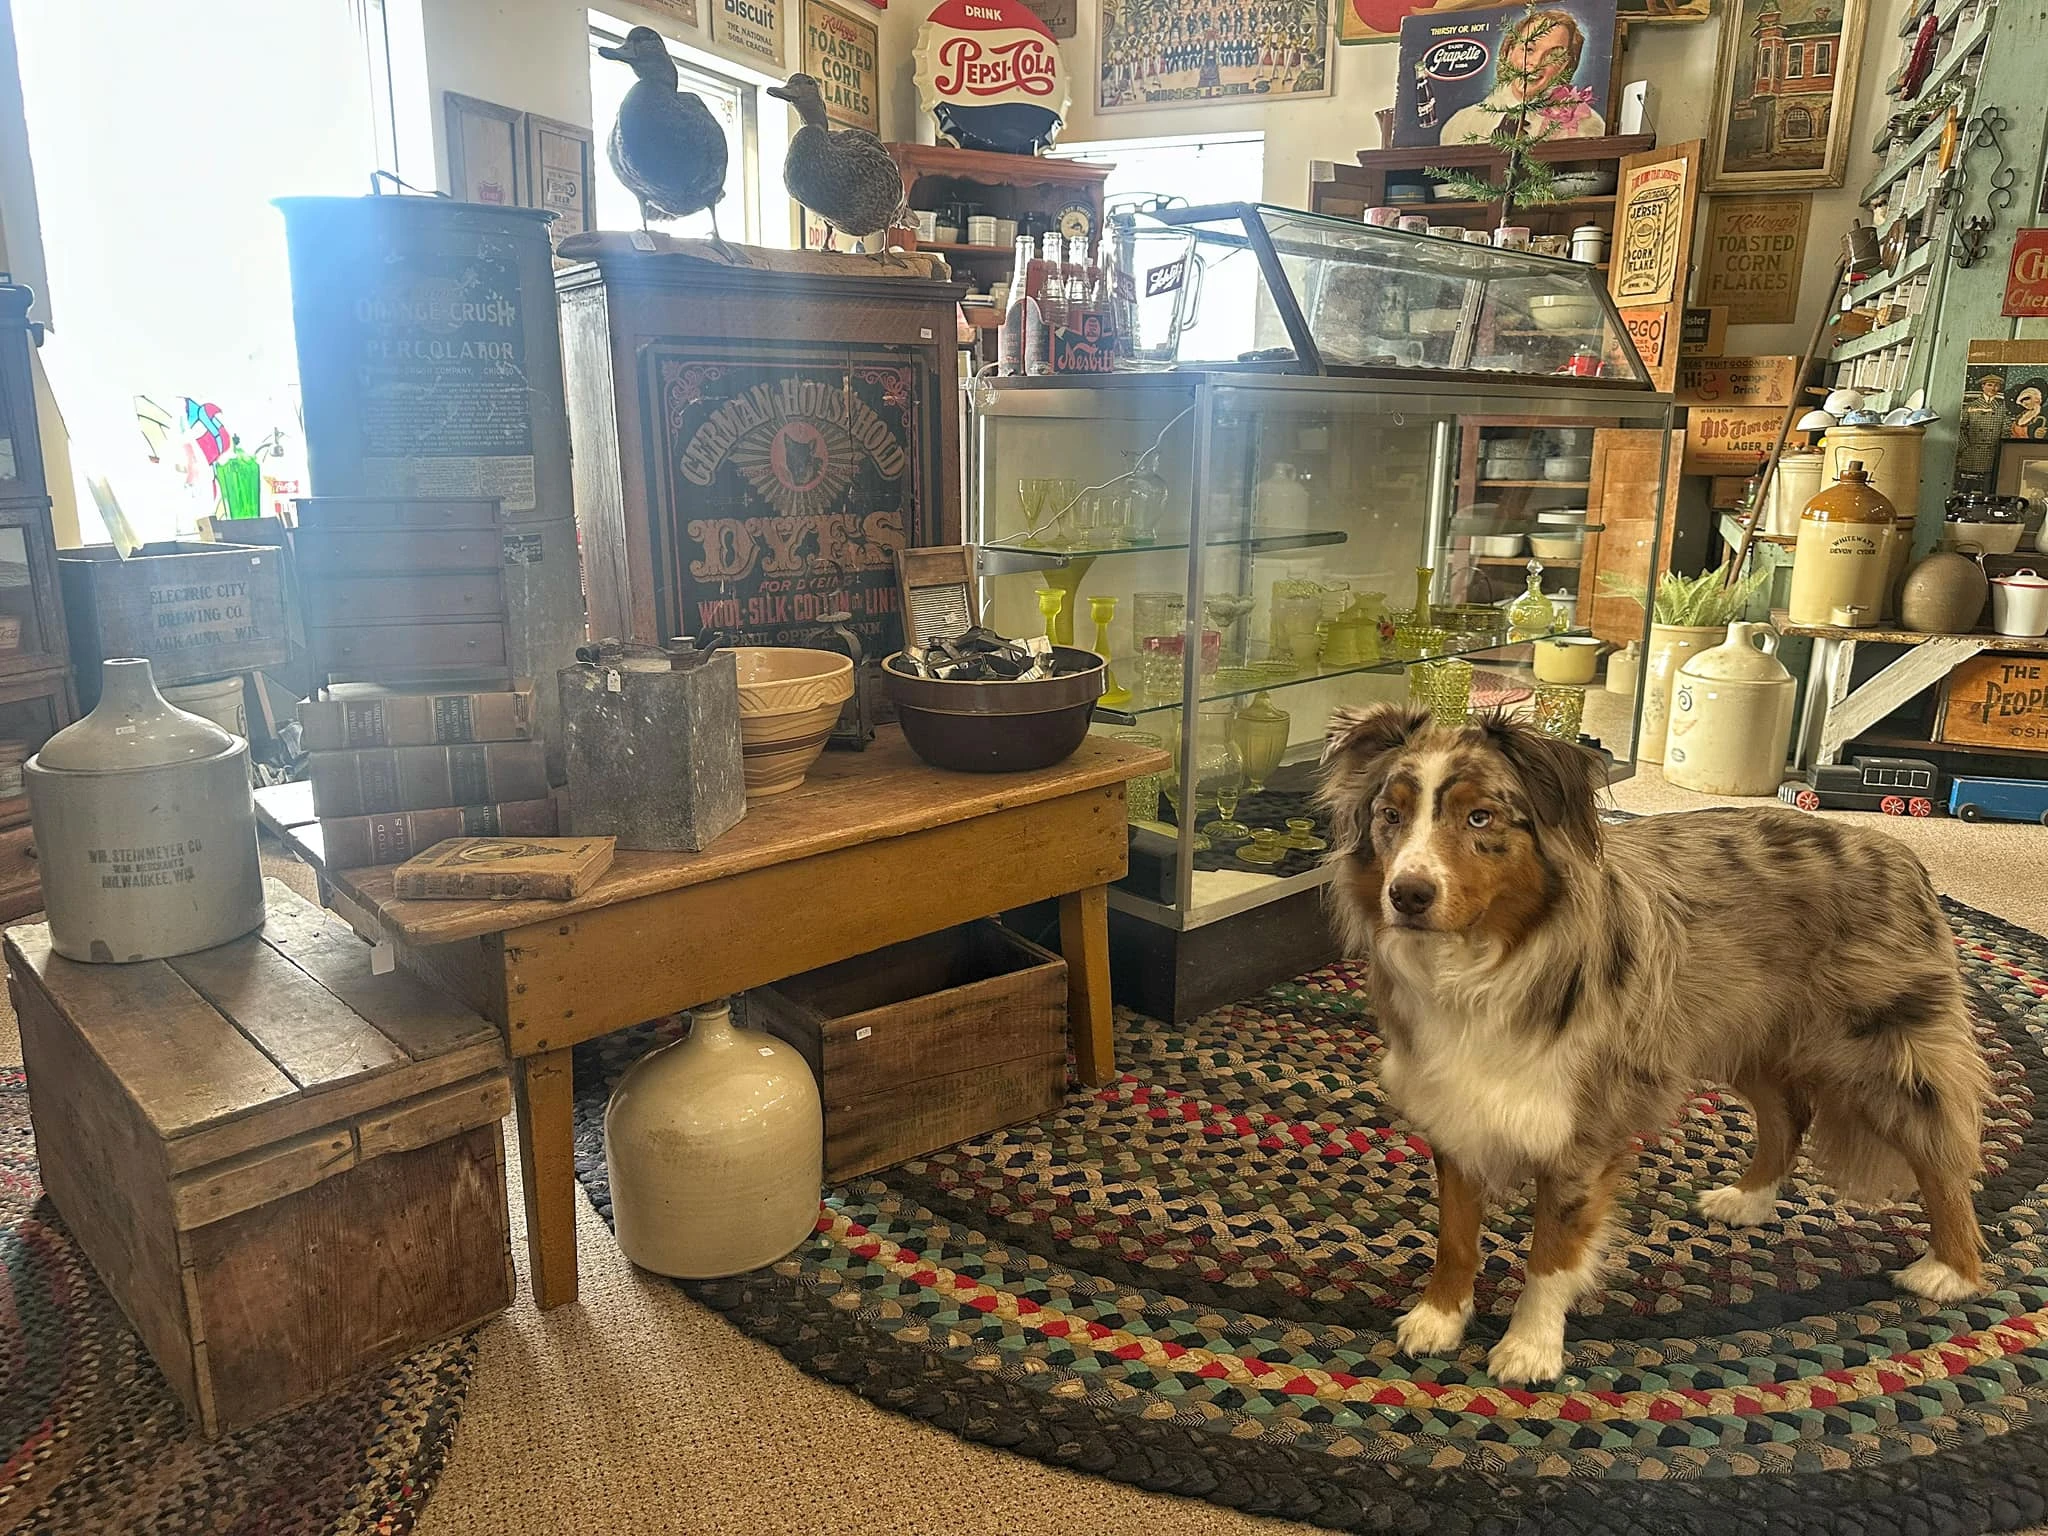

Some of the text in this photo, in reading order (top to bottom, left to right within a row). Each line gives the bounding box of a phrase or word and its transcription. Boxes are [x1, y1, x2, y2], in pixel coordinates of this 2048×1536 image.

[725, 0, 774, 30] Biscuit
[965, 5, 1003, 22] DRINK
[727, 21, 774, 47] THE NATIONAL
[727, 33, 744, 45] SODA
[1430, 25, 1458, 36] THIRSTY
[1457, 24, 1469, 34] OR
[808, 25, 873, 71] TOASTED
[1429, 45, 1481, 72] Grapette
[822, 56, 861, 90] CORN
[814, 77, 870, 115] LAKES
[1145, 80, 1271, 102] MINSTRELS
[1722, 213, 1799, 236] Kellogg's
[808, 226, 837, 250] DRIK
[1717, 234, 1795, 252] TOASTED
[1631, 248, 1653, 261] CORN
[1726, 254, 1782, 272] CORN
[1712, 273, 1789, 291] FLAKES
[366, 340, 515, 361] PERCOLATOR
[1704, 359, 1728, 369] FRUIT
[1729, 373, 1768, 384] Orange
[1733, 384, 1761, 395] Drink
[680, 381, 778, 487] GERMAN
[778, 377, 906, 481] HOUSEHOLD
[1727, 441, 1762, 451] LAGER
[687, 510, 907, 583] DYES
[150, 582, 247, 605] ELECTRIC CITY
[759, 579, 792, 594] FOR
[158, 607, 222, 628] BREWING
[2000, 664, 2041, 684] THE
